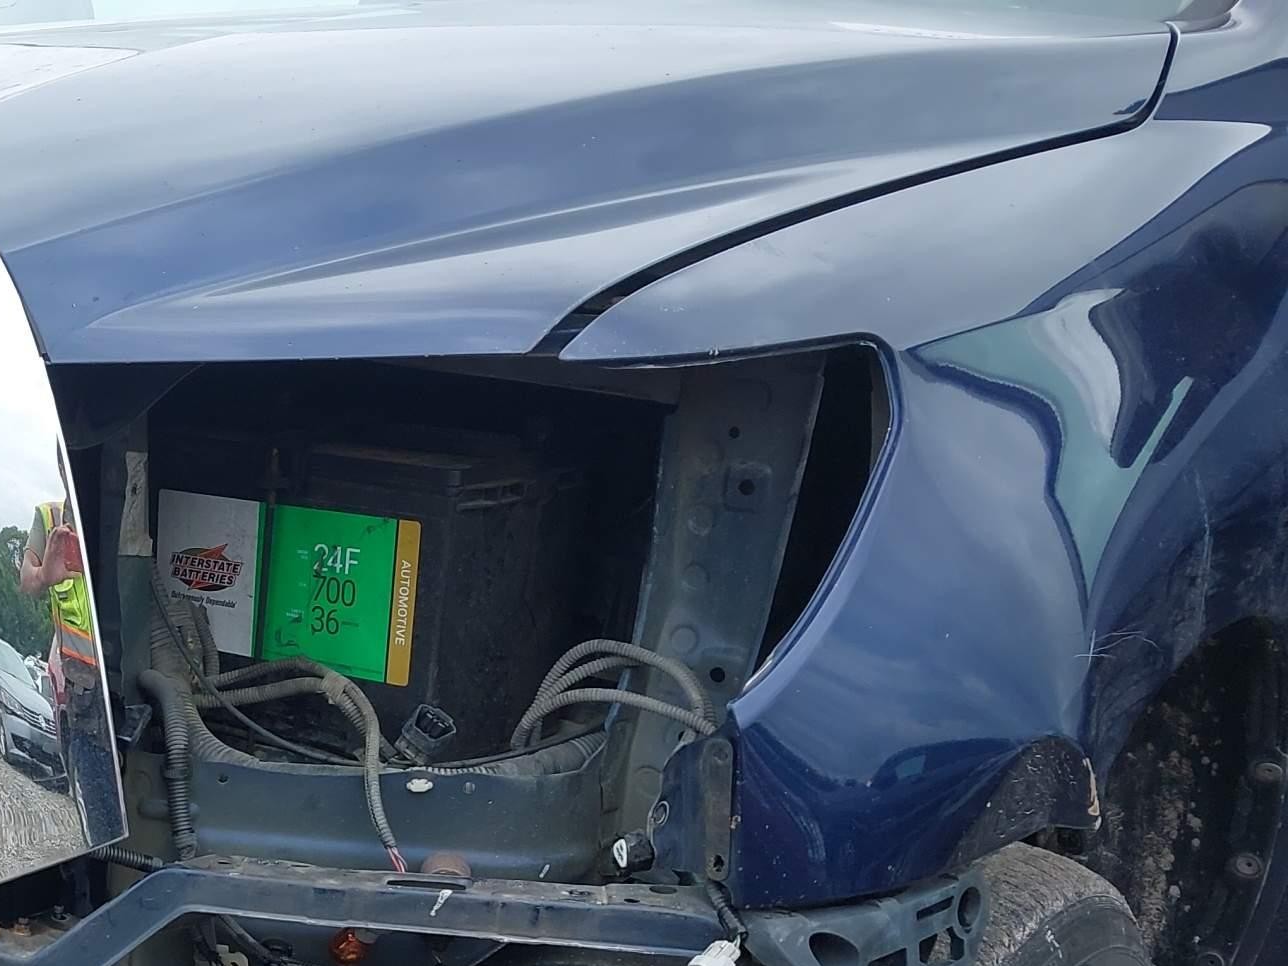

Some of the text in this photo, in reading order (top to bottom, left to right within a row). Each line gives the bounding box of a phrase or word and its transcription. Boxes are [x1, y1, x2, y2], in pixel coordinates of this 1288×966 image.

[171, 554, 241, 574] INTERSTATE
[313, 544, 360, 574] 24F
[173, 567, 234, 585] BATTERIES
[312, 574, 355, 606] 700
[395, 560, 411, 645] AUTOMOTIVE
[311, 606, 339, 634] 36
